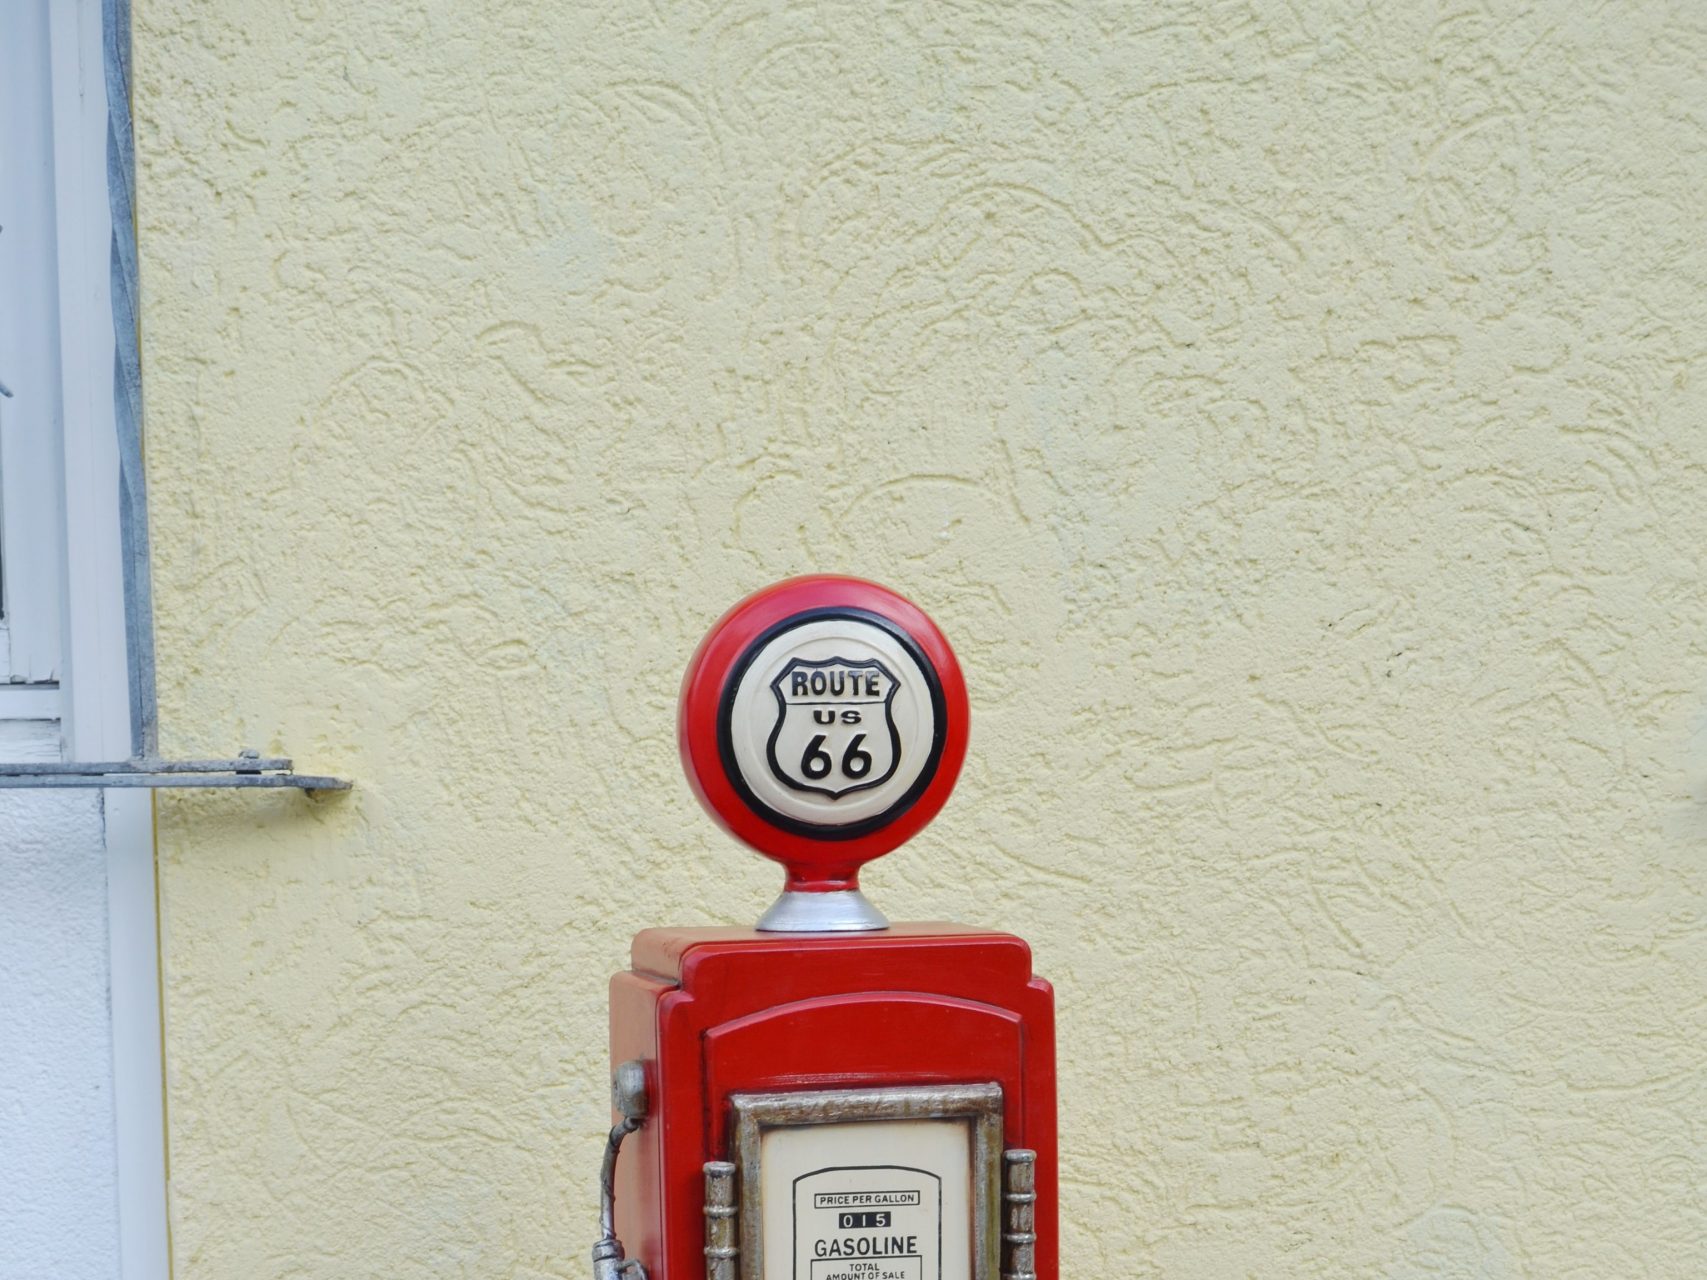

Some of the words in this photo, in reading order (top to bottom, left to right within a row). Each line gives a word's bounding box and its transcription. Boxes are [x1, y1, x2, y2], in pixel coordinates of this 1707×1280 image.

[791, 670, 881, 697] ROUTE
[813, 710, 862, 725] US
[801, 733, 873, 780] 66
[820, 1196, 850, 1205] PRICE
[852, 1195, 872, 1204] PER
[874, 1194, 915, 1203] GALLON
[814, 1235, 918, 1257] GASOLINE
[849, 1263, 880, 1272] TOTAL
[826, 1272, 866, 1280] AMOUNT
[868, 1271, 880, 1280] OF
[882, 1271, 905, 1280] SALE
